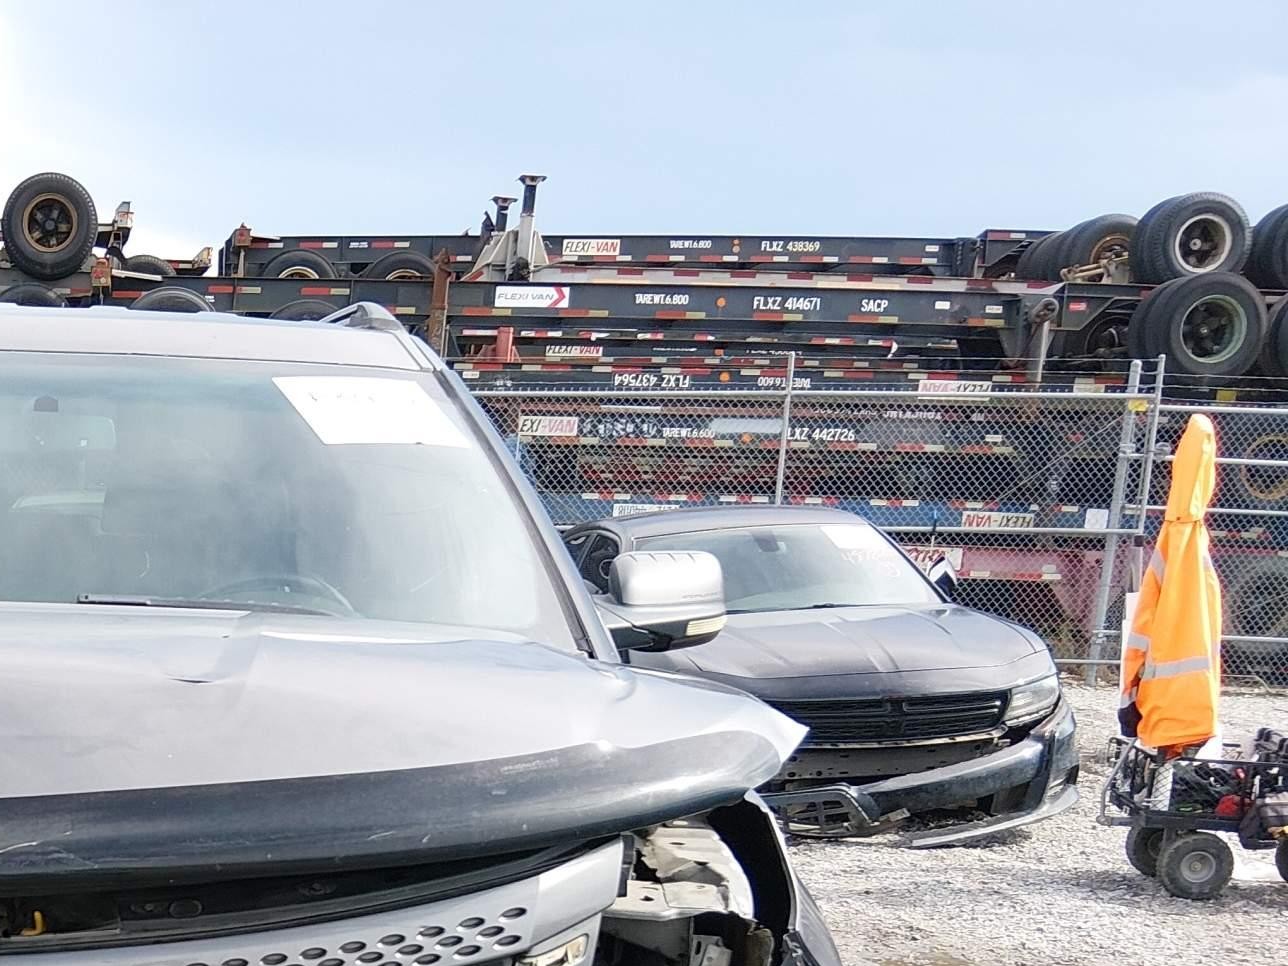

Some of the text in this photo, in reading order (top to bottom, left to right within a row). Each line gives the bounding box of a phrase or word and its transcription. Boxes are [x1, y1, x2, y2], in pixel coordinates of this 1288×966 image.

[564, 240, 618, 253] FLEXI-VAN
[761, 241, 820, 252] FLXZ 438369
[531, 292, 554, 301] VAN
[753, 297, 821, 310] FLXZ 414671
[861, 299, 889, 313] SACP
[614, 373, 690, 387] FLXZ 437564
